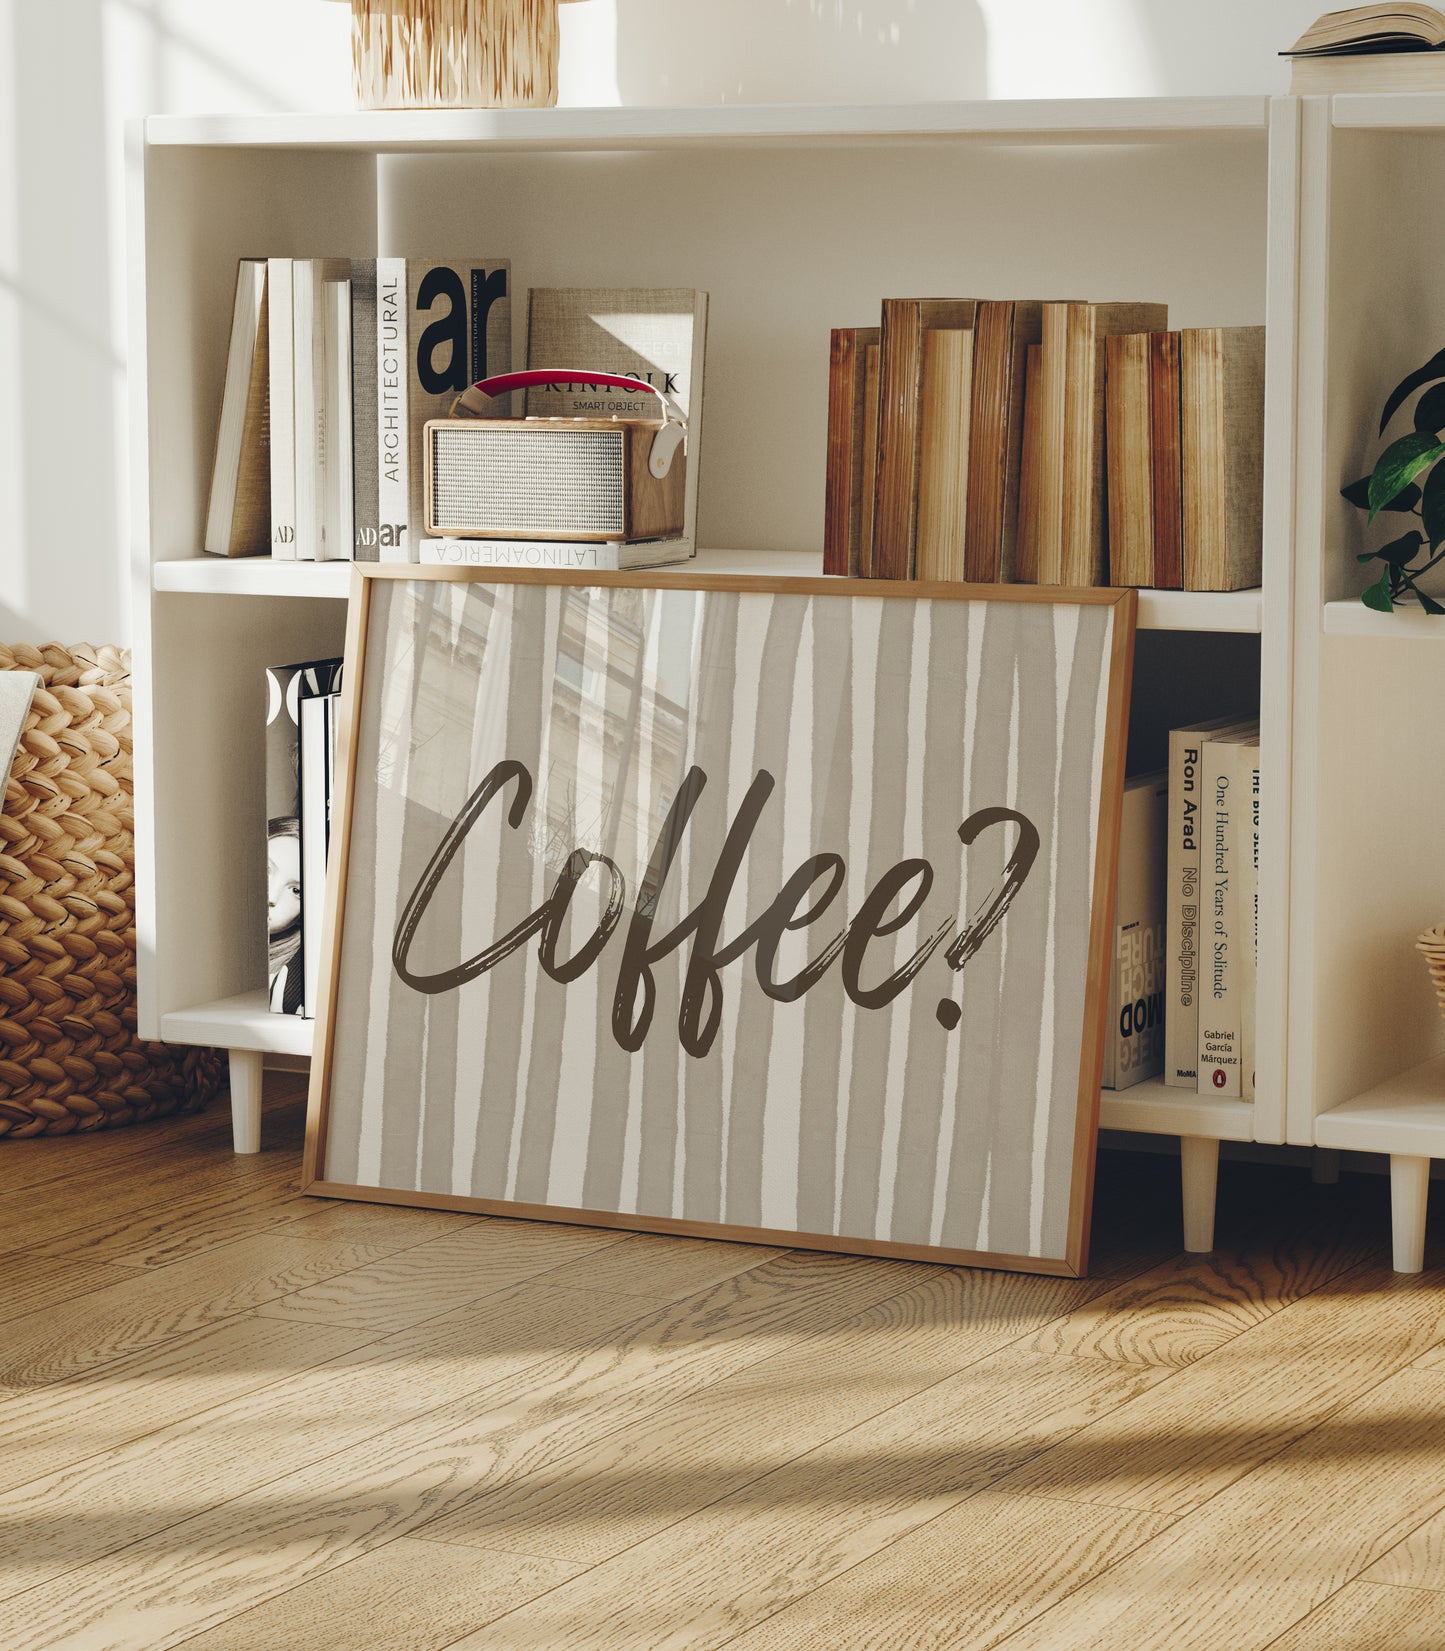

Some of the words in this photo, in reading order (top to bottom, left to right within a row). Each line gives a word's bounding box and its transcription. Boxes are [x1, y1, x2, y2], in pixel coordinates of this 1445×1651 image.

[416, 266, 507, 395] ar
[383, 276, 399, 483] ARCHITECTURAL
[573, 402, 606, 411] SMART
[608, 402, 645, 411] OBJECT
[274, 525, 294, 544] AD
[356, 527, 378, 546] AD
[380, 523, 407, 547] ar
[434, 545, 598, 567] LATINOAMERICA
[1183, 749, 1198, 792] Ron
[1216, 776, 1229, 807] One
[1183, 799, 1198, 850] Arad
[1215, 811, 1229, 874] Hundred
[1182, 868, 1198, 897] No
[392, 760, 1040, 1058] Coffee?
[1214, 879, 1228, 917] Years
[1214, 921, 1228, 938] of
[1179, 905, 1197, 1007] Discipline
[1213, 942, 1228, 999] Solitude
[1203, 1030, 1235, 1041] Gabriel
[1205, 1042, 1232, 1053] García
[1176, 1069, 1197, 1078] MoMA
[1200, 1054, 1237, 1065] Márquez
